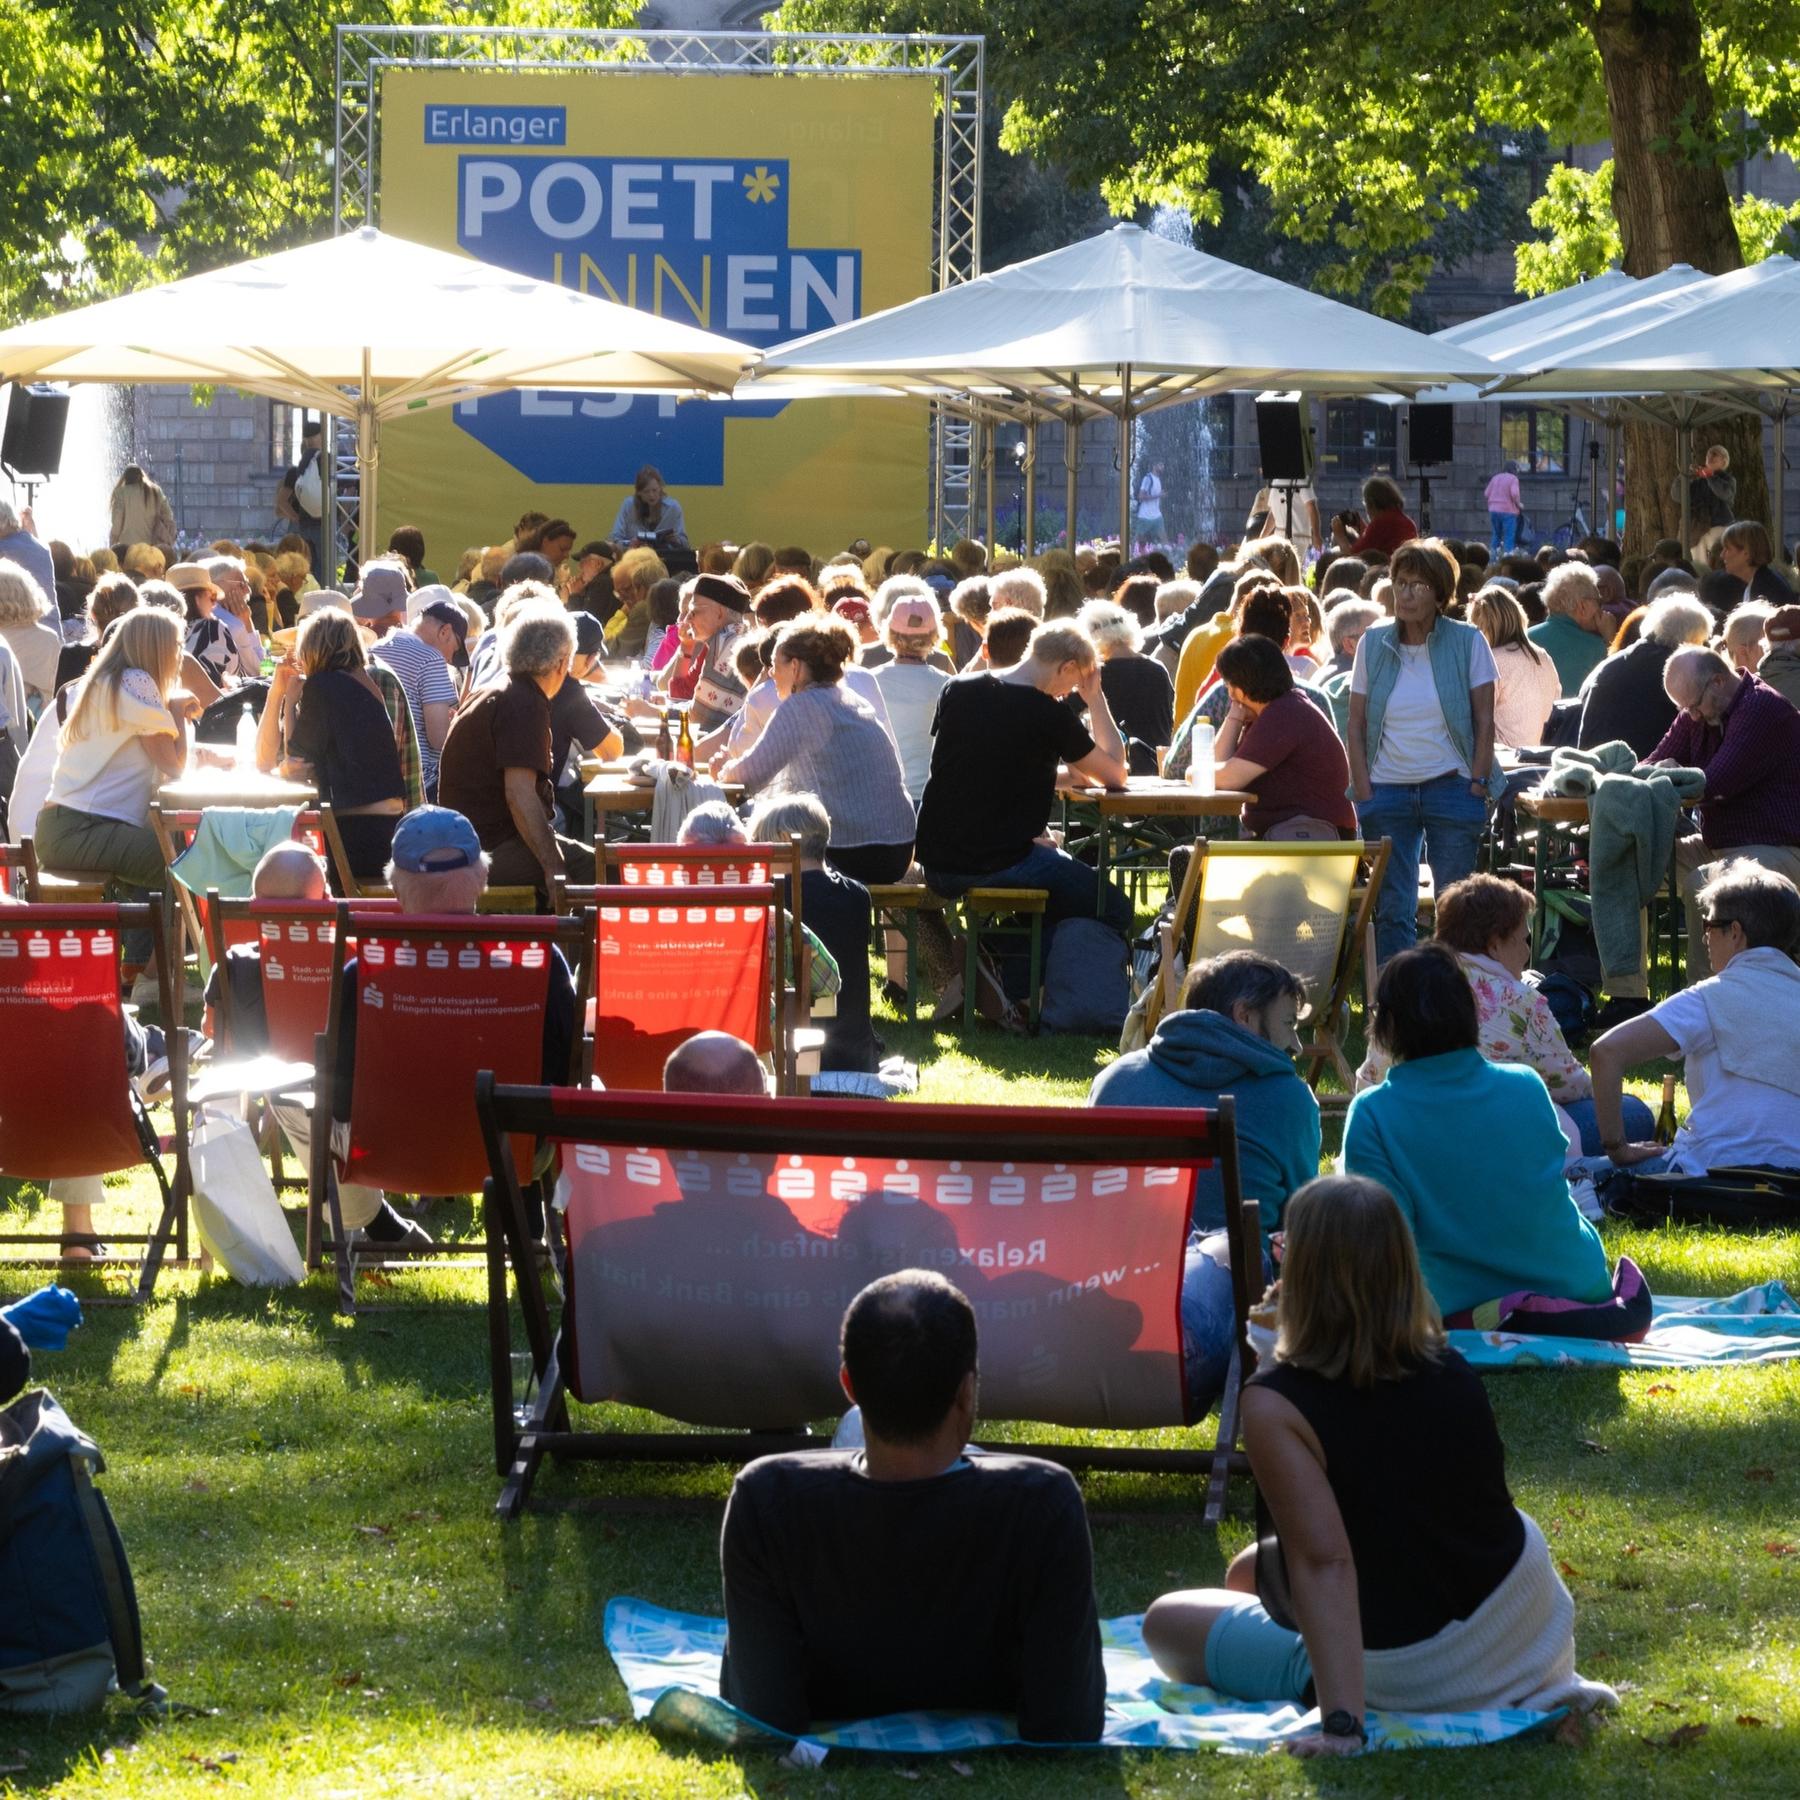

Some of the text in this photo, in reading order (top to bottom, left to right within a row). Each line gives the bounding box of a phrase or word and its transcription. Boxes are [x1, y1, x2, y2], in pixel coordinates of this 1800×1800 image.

[432, 108, 560, 143] Erlanger
[316, 966, 330, 974] und
[420, 994, 436, 1004] und
[438, 997, 499, 1006] Kreissparkasse
[393, 1003, 541, 1015] Erlangen Höchstadt Herzogenaurach
